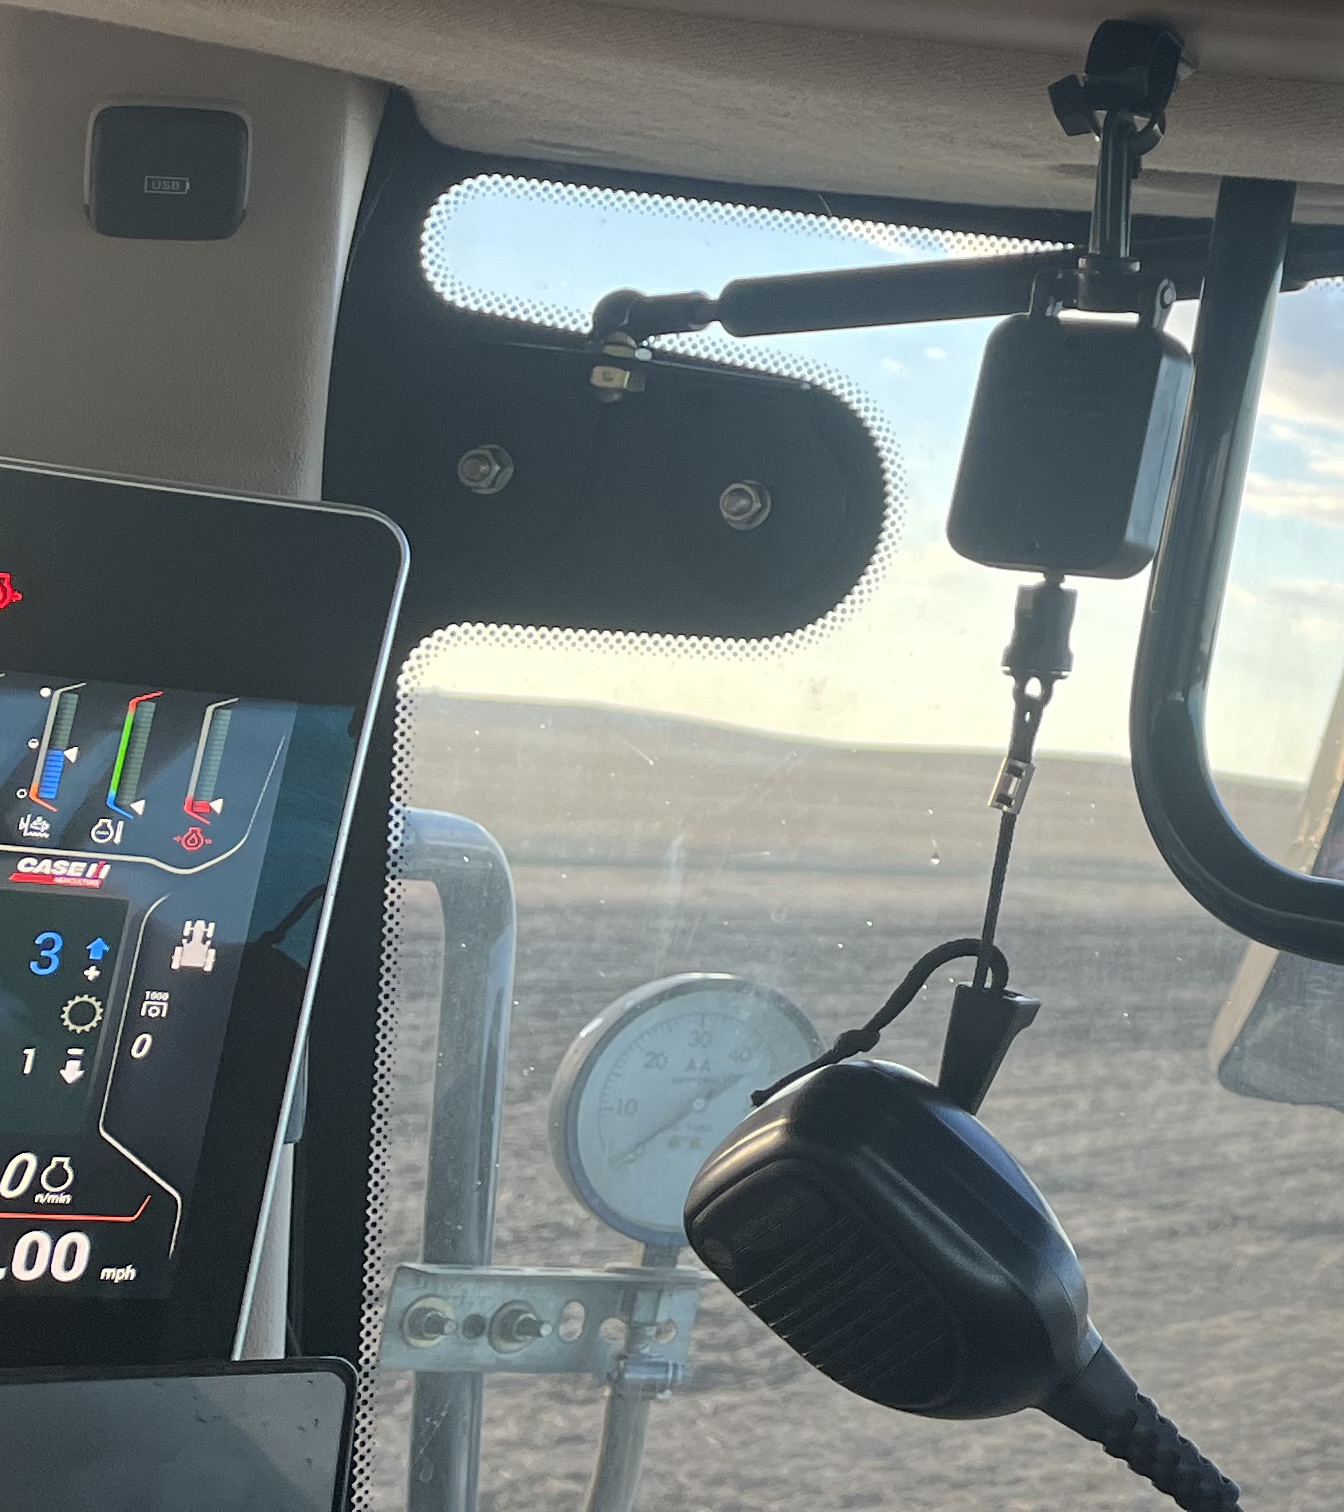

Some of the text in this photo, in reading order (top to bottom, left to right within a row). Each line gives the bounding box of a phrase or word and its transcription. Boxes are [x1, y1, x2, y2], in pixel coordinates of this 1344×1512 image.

[151, 179, 181, 191] USB
[17, 857, 88, 877] CASE
[29, 930, 64, 976] 3
[145, 990, 170, 1001] 1000
[130, 1033, 153, 1060] 0
[687, 1029, 713, 1049] 30
[22, 1047, 37, 1076] 1
[643, 1050, 669, 1070] 20
[616, 1097, 639, 1117] 10
[0, 1151, 38, 1199] 0
[34, 1191, 73, 1205] n/min
[99, 1264, 138, 1284] mph
